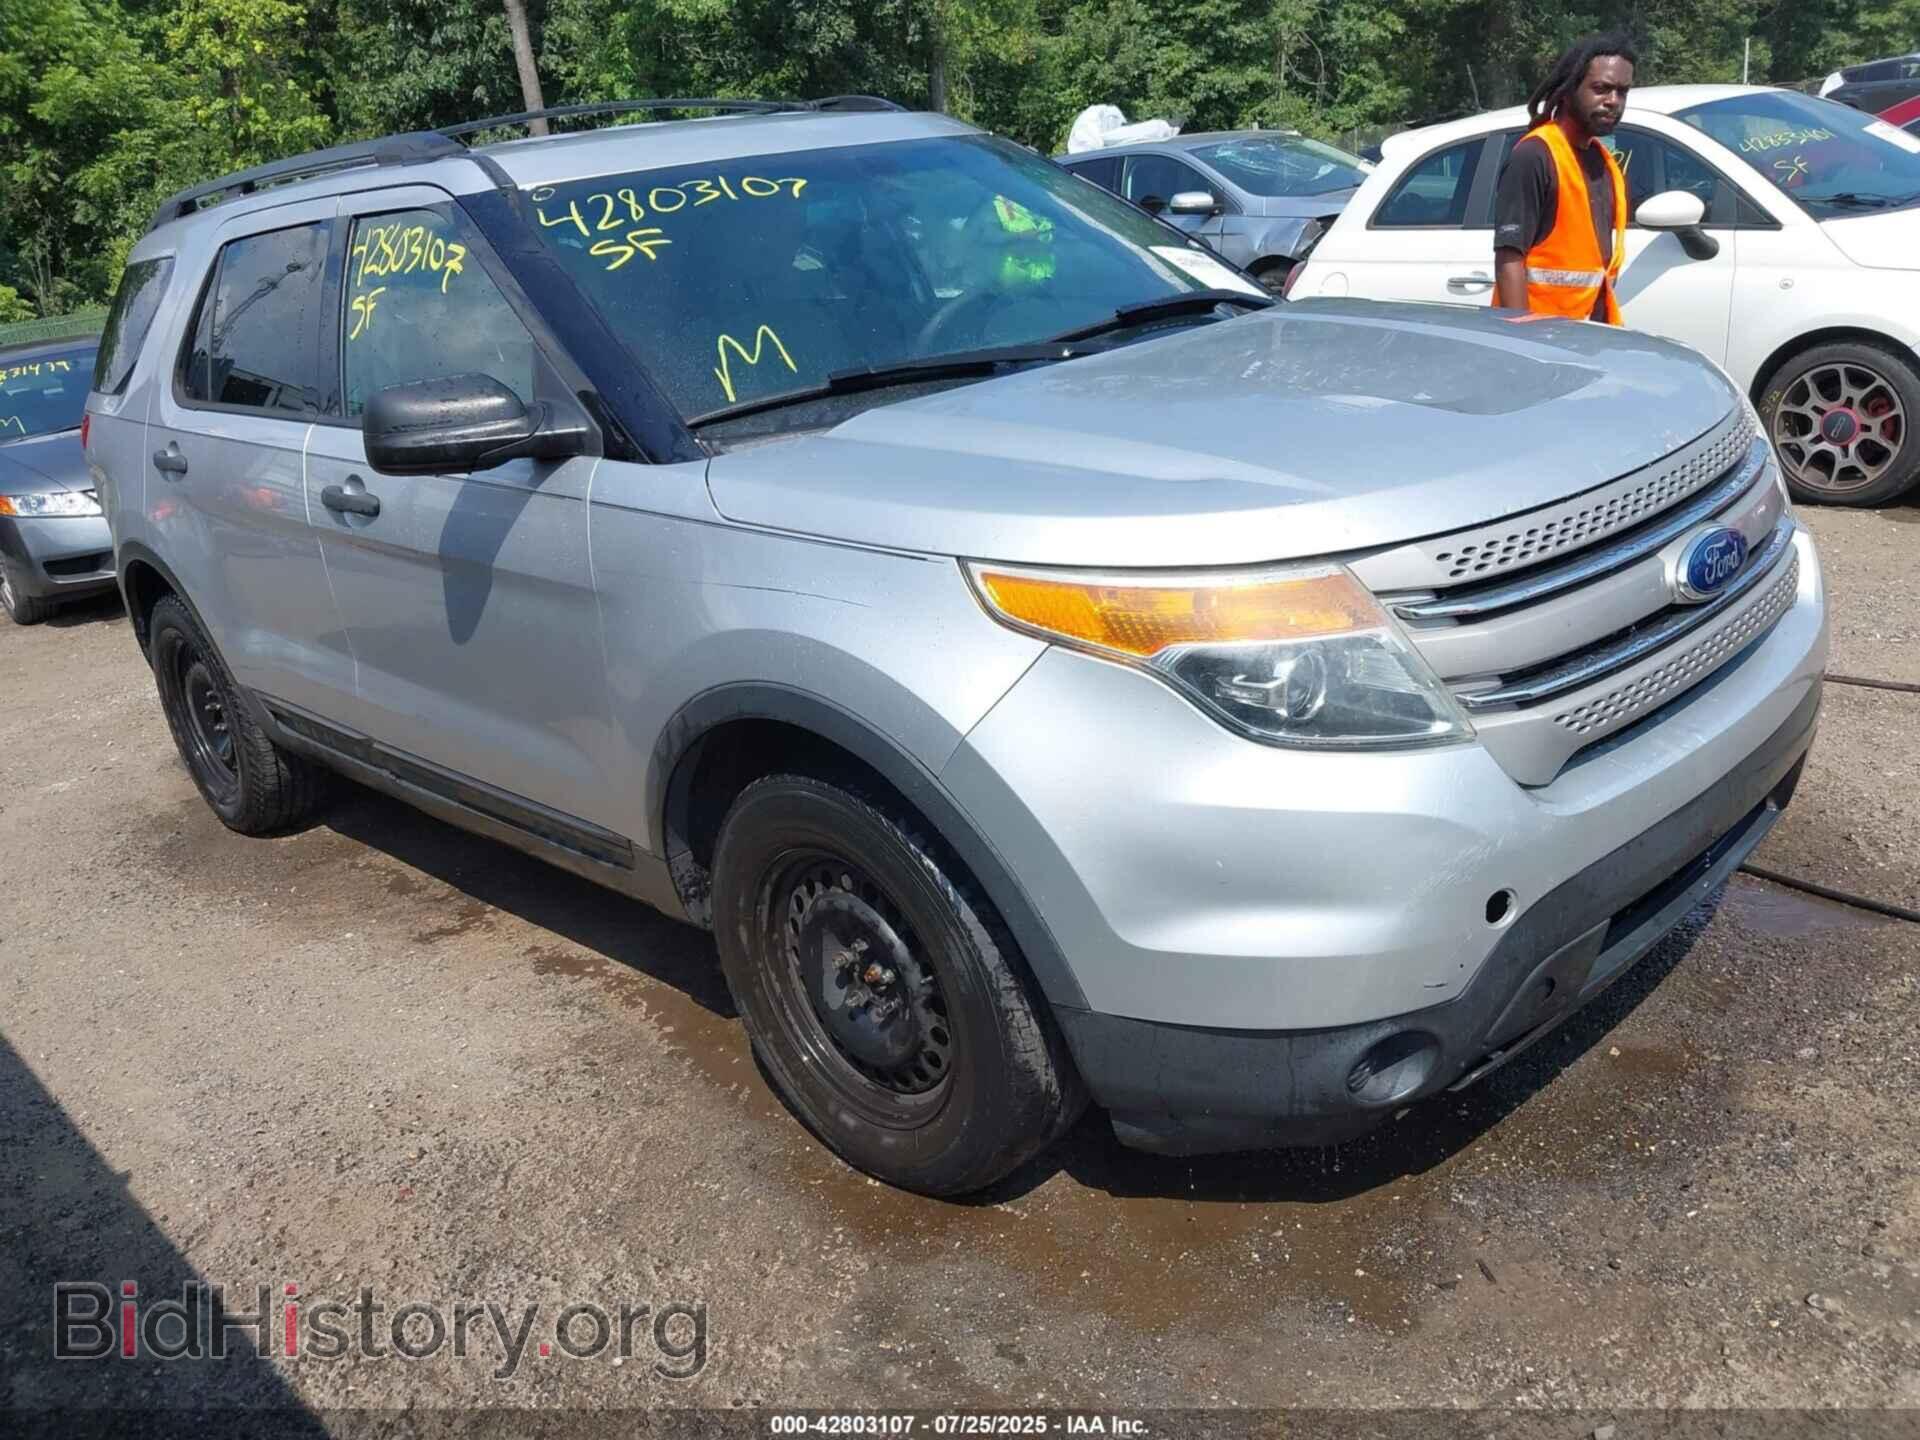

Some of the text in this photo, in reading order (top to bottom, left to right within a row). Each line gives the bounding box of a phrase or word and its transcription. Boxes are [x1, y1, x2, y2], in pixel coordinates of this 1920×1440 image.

[537, 175, 807, 237] 42803107
[353, 221, 465, 294] 42803107
[589, 228, 672, 270] SF
[350, 286, 386, 340] SF
[714, 325, 798, 402] M
[1704, 539, 1739, 584] Ford
